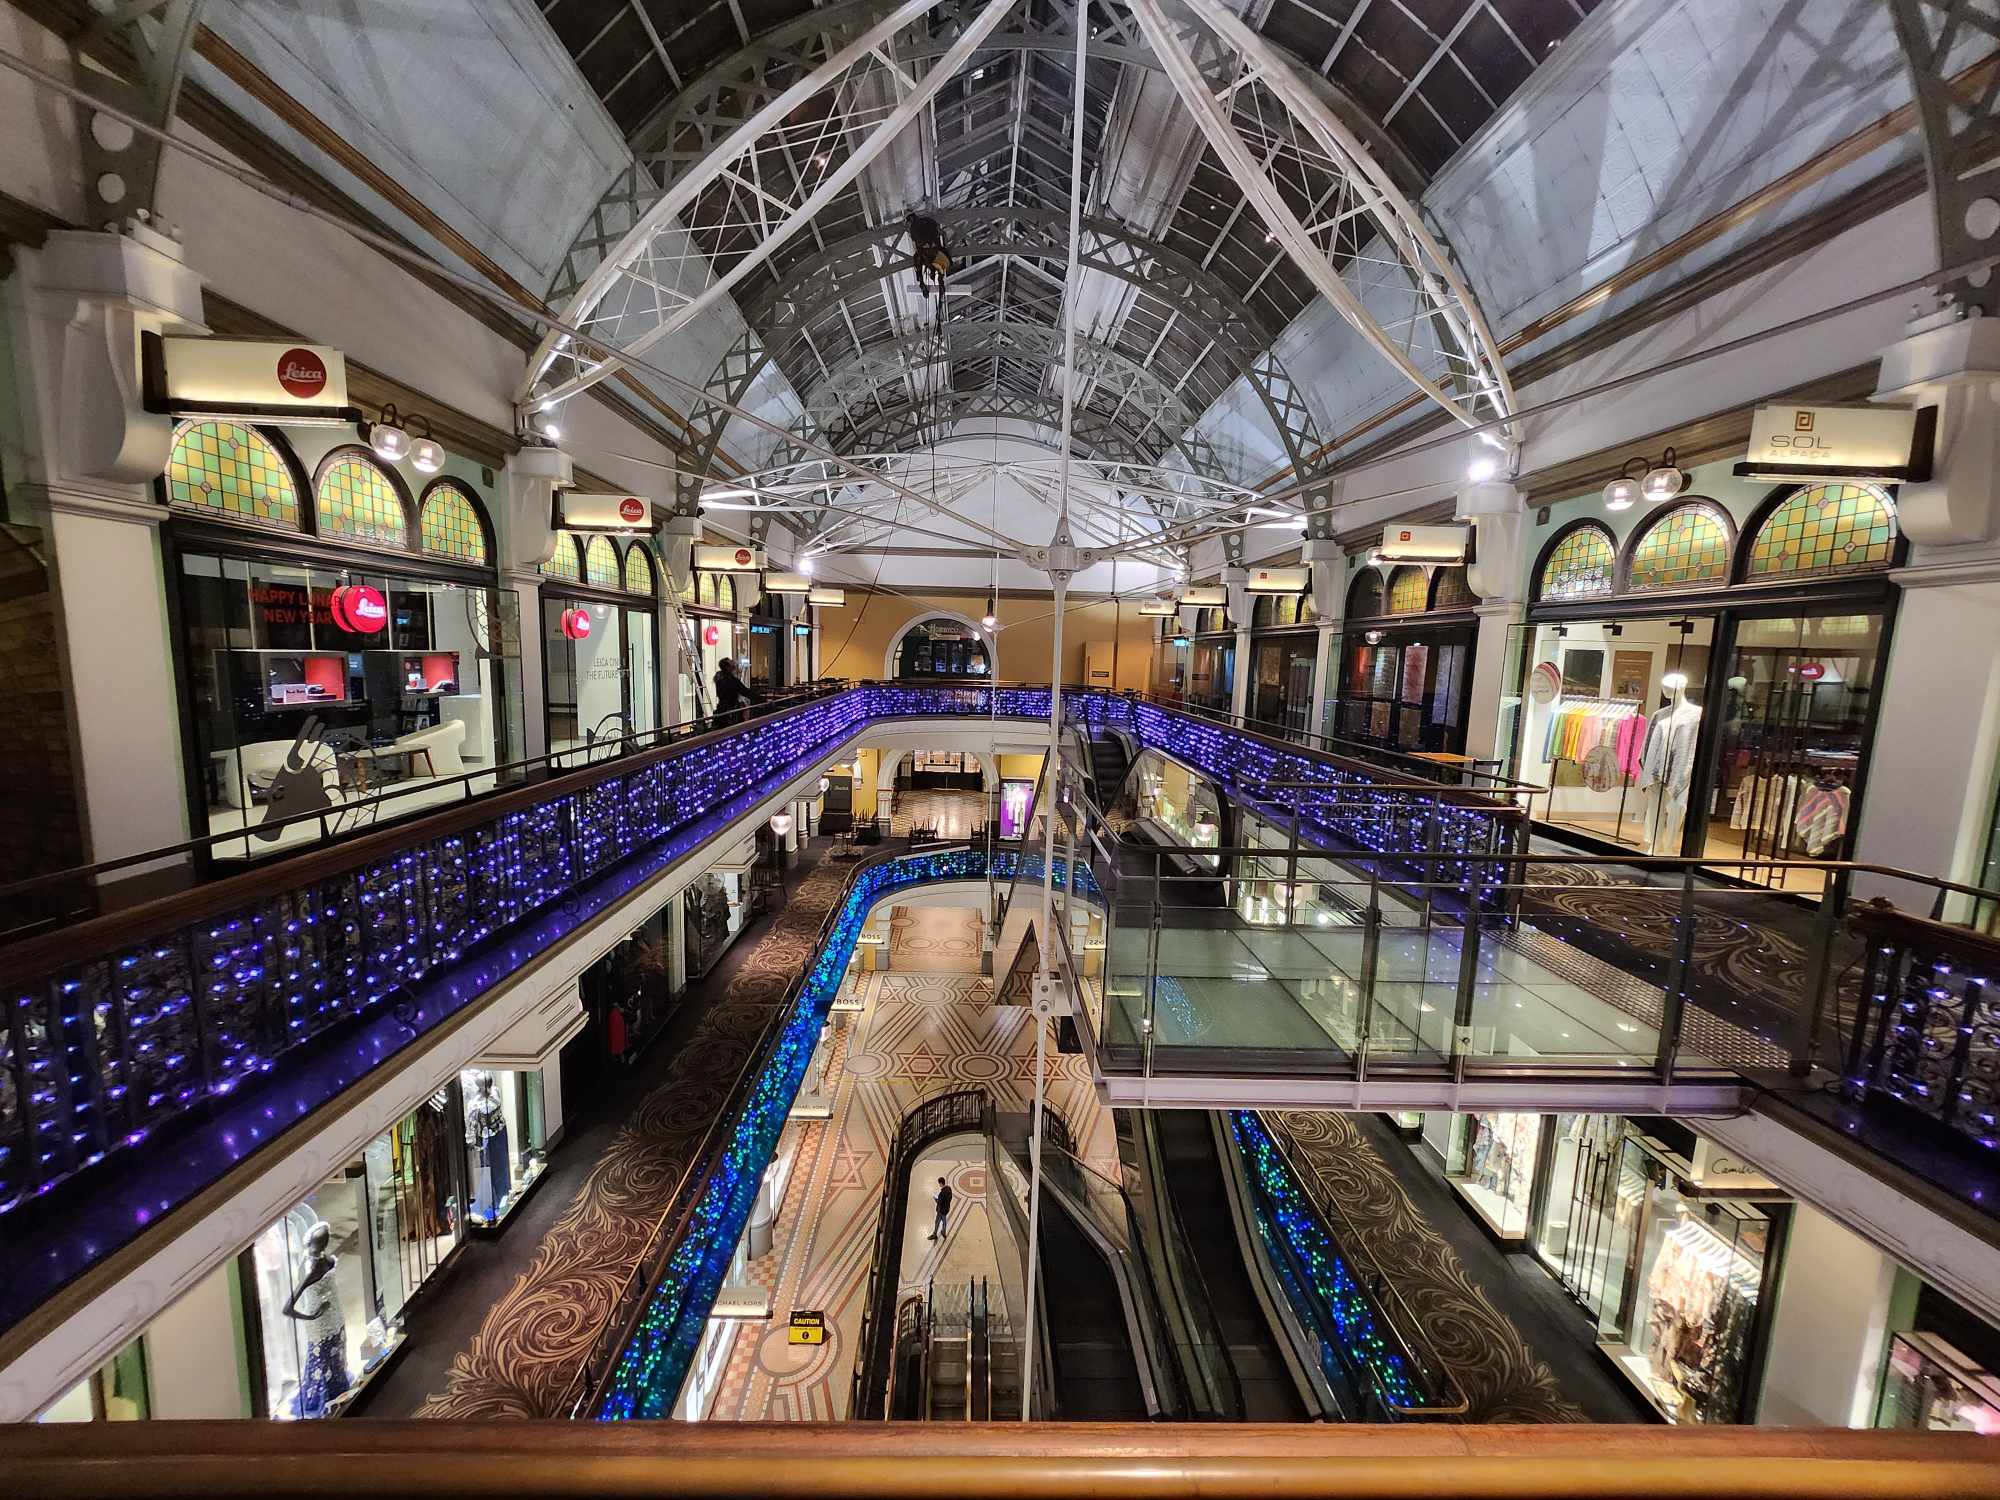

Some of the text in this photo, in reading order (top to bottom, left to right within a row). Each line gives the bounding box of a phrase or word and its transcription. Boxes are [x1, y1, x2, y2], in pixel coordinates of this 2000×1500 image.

[280, 361, 322, 383] Leica
[1771, 435, 1832, 448] SOL
[1769, 449, 1831, 459] ALPACA
[251, 590, 295, 605] HAPPY
[263, 609, 332, 624] NEW YEAR
[793, 1318, 820, 1326] CAUTION
